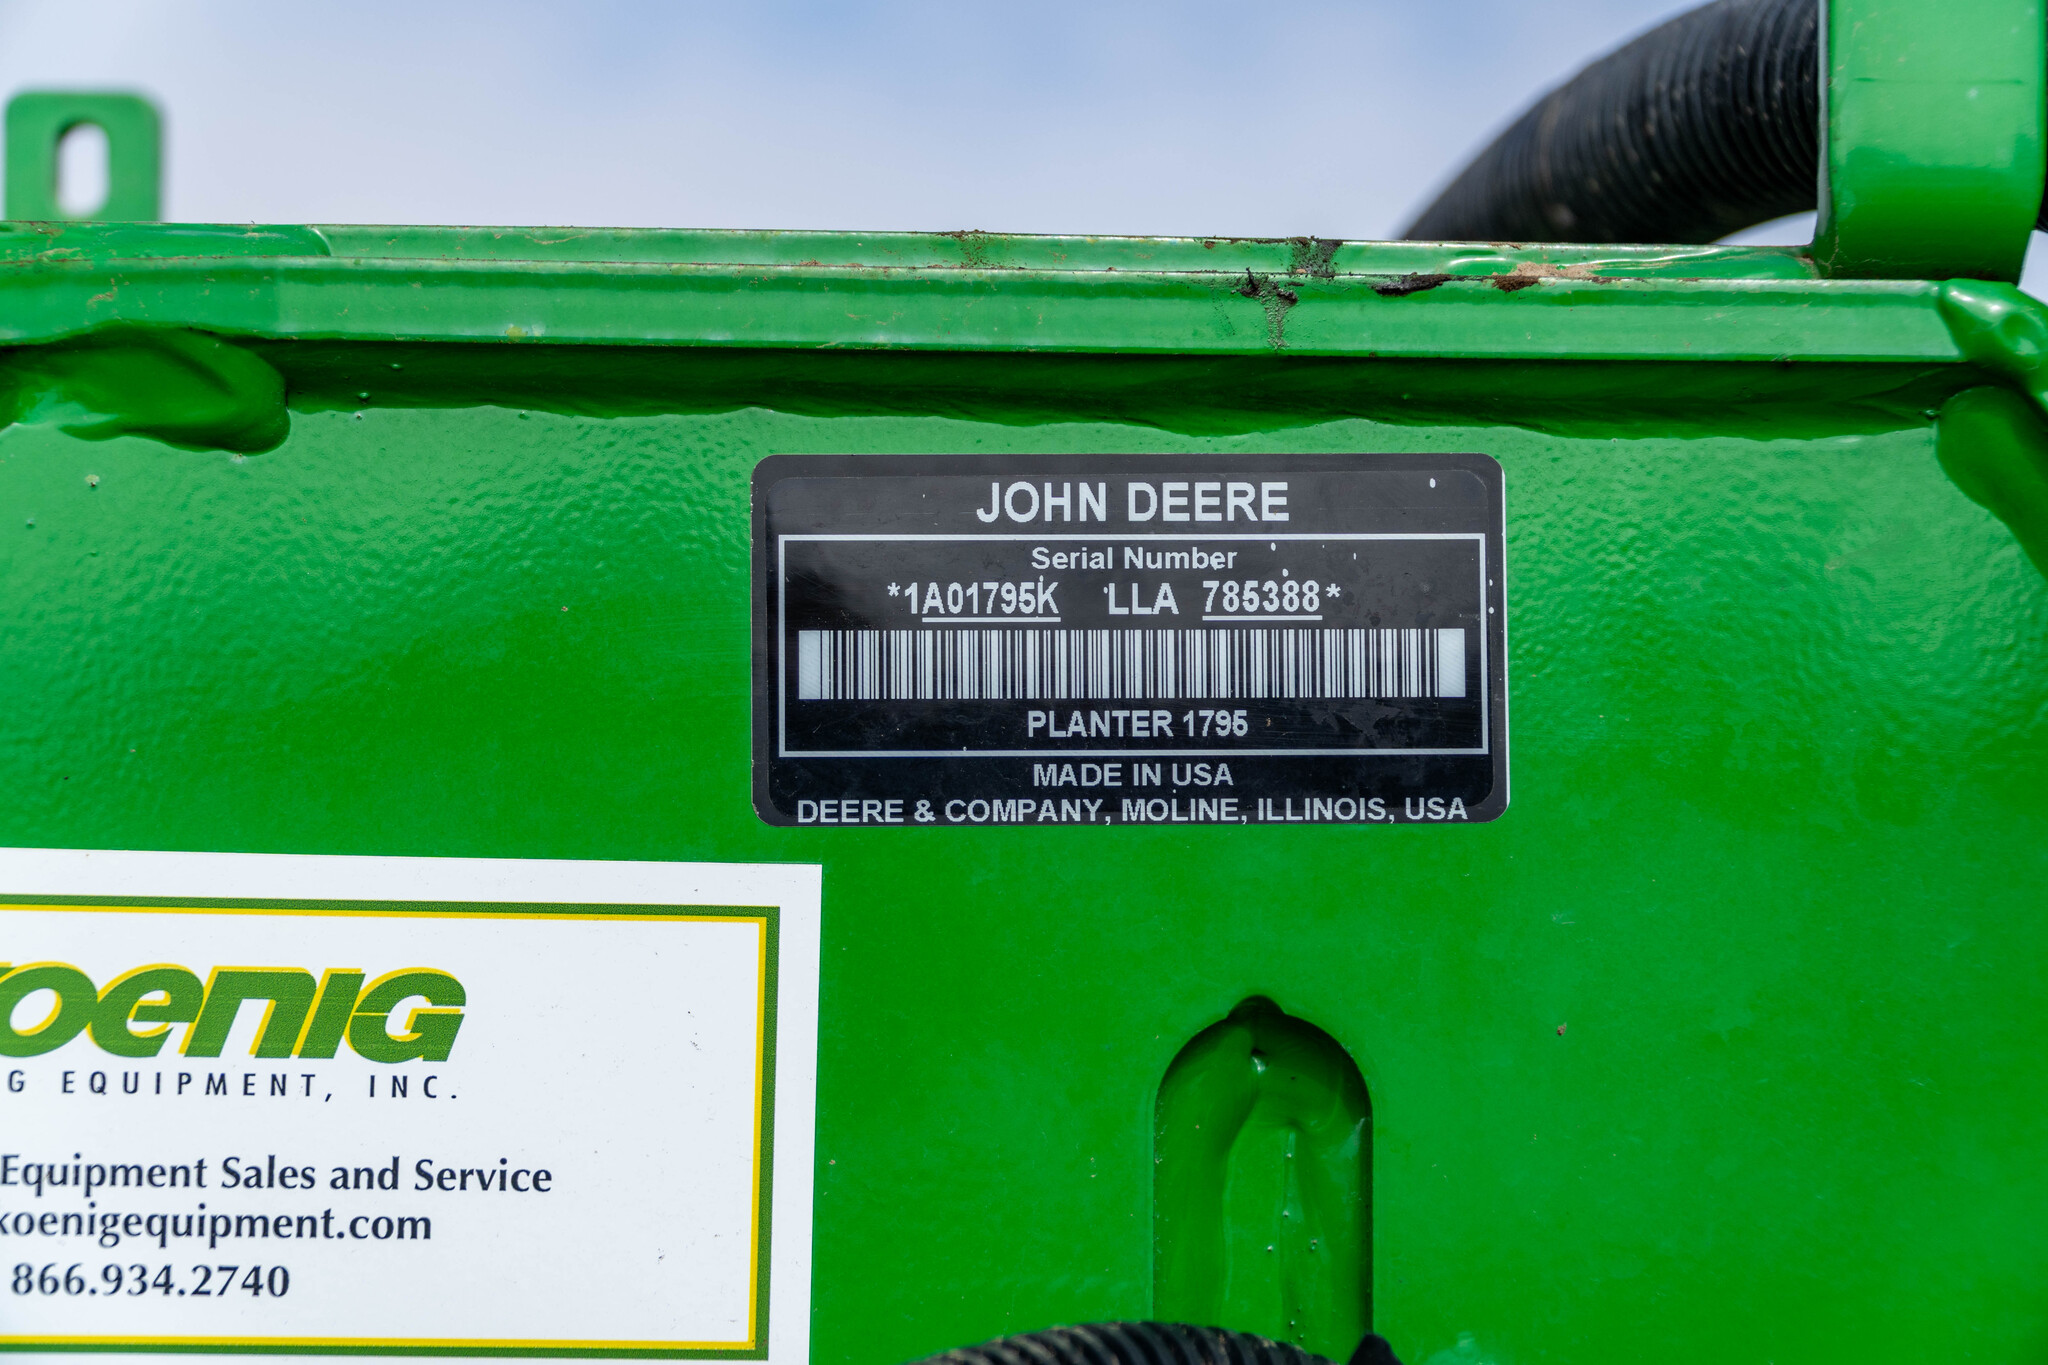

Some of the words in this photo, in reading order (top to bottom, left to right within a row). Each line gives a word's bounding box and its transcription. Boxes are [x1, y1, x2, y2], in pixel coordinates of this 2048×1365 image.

[976, 480, 1107, 523] JOHN
[1127, 481, 1290, 522] DEERE
[1031, 546, 1113, 570] Serial
[1124, 546, 1238, 570] Number
[1108, 582, 1180, 615] LLA
[1028, 709, 1174, 738] PLANTER
[1183, 709, 1249, 737] 1795
[1033, 763, 1123, 787] MADE
[1133, 763, 1161, 786] IN
[1172, 763, 1234, 786] USA
[797, 799, 905, 823] DEERE
[913, 799, 937, 823] &
[945, 798, 1111, 825] COMPANY,
[1121, 798, 1248, 825] MOLINE,
[1258, 797, 1395, 825] ILLINOIS,
[1405, 797, 1469, 820] USA
[61, 1070, 333, 1103] EQUIPMENT,
[369, 1075, 458, 1100] INC.
[0, 1152, 208, 1198] Equipment
[220, 1156, 316, 1190] Sales
[328, 1156, 400, 1191] and
[413, 1157, 553, 1193] Service
[11, 1263, 291, 1297] 866.934.2740
